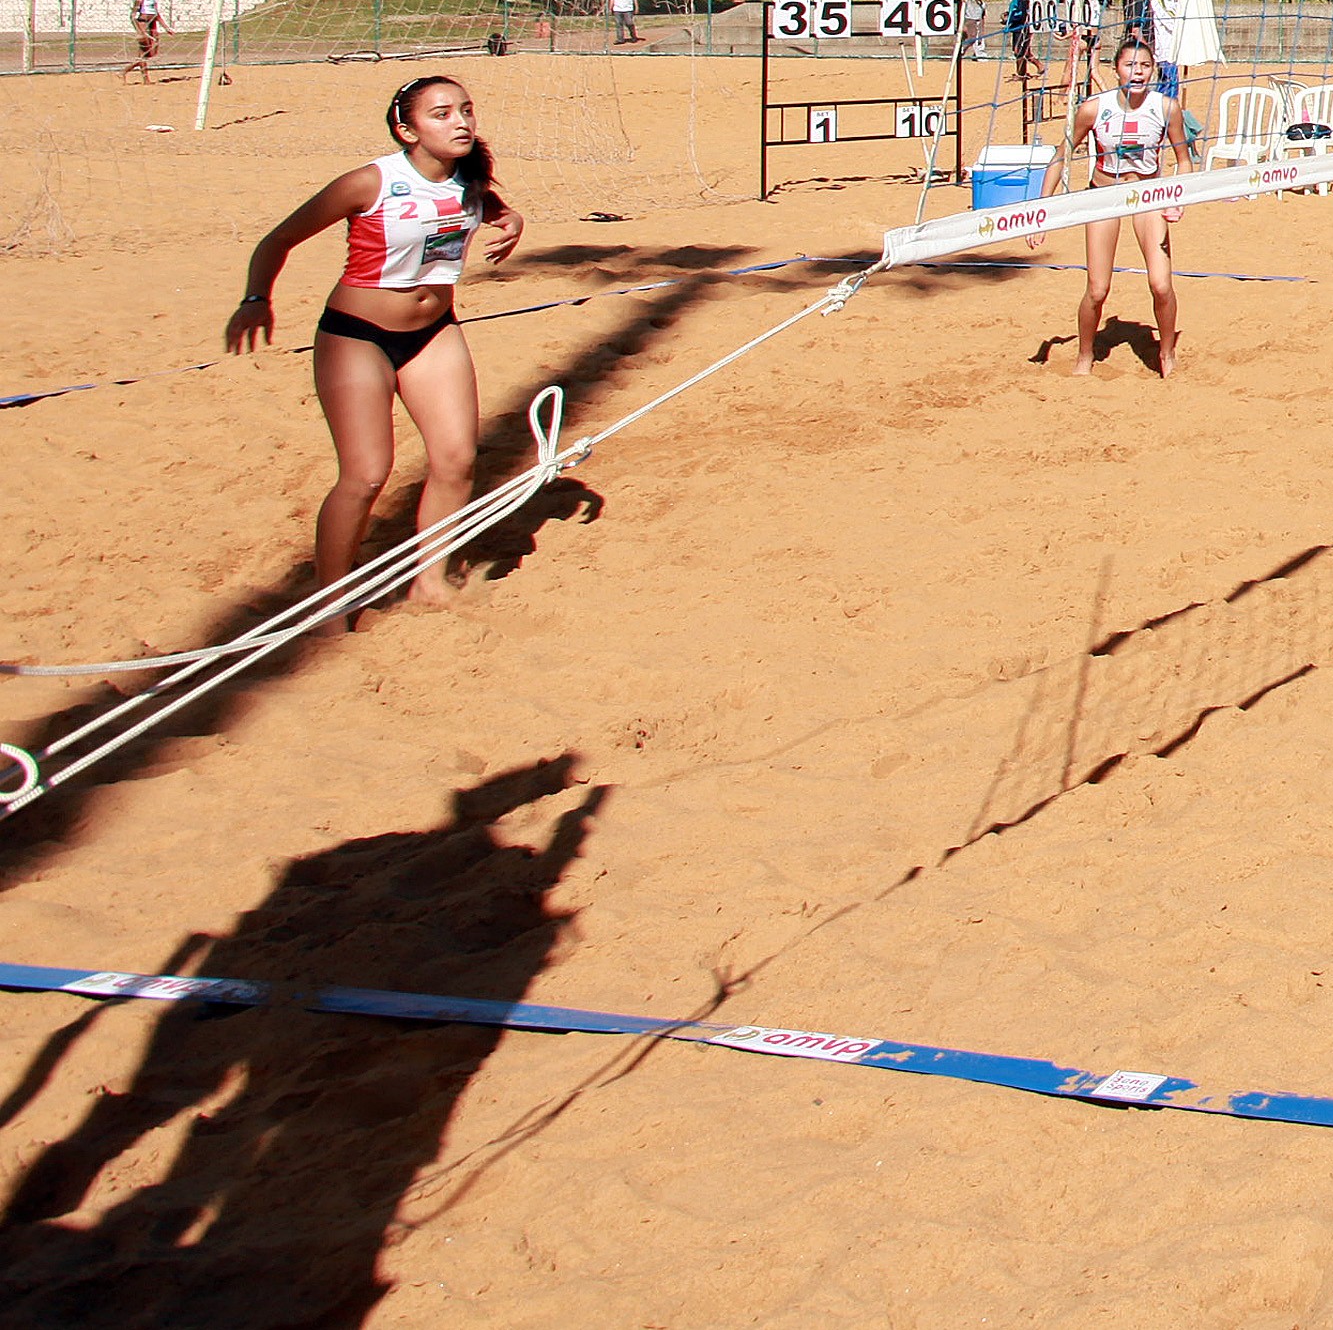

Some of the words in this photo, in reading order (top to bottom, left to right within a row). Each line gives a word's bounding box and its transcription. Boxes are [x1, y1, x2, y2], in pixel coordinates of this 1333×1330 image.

[816, 117, 830, 142] 1
[1262, 166, 1298, 183] amvp
[1142, 185, 1183, 203] amvp
[400, 202, 419, 220] 2
[997, 208, 1047, 232] amvp
[763, 1033, 870, 1056] amvp
